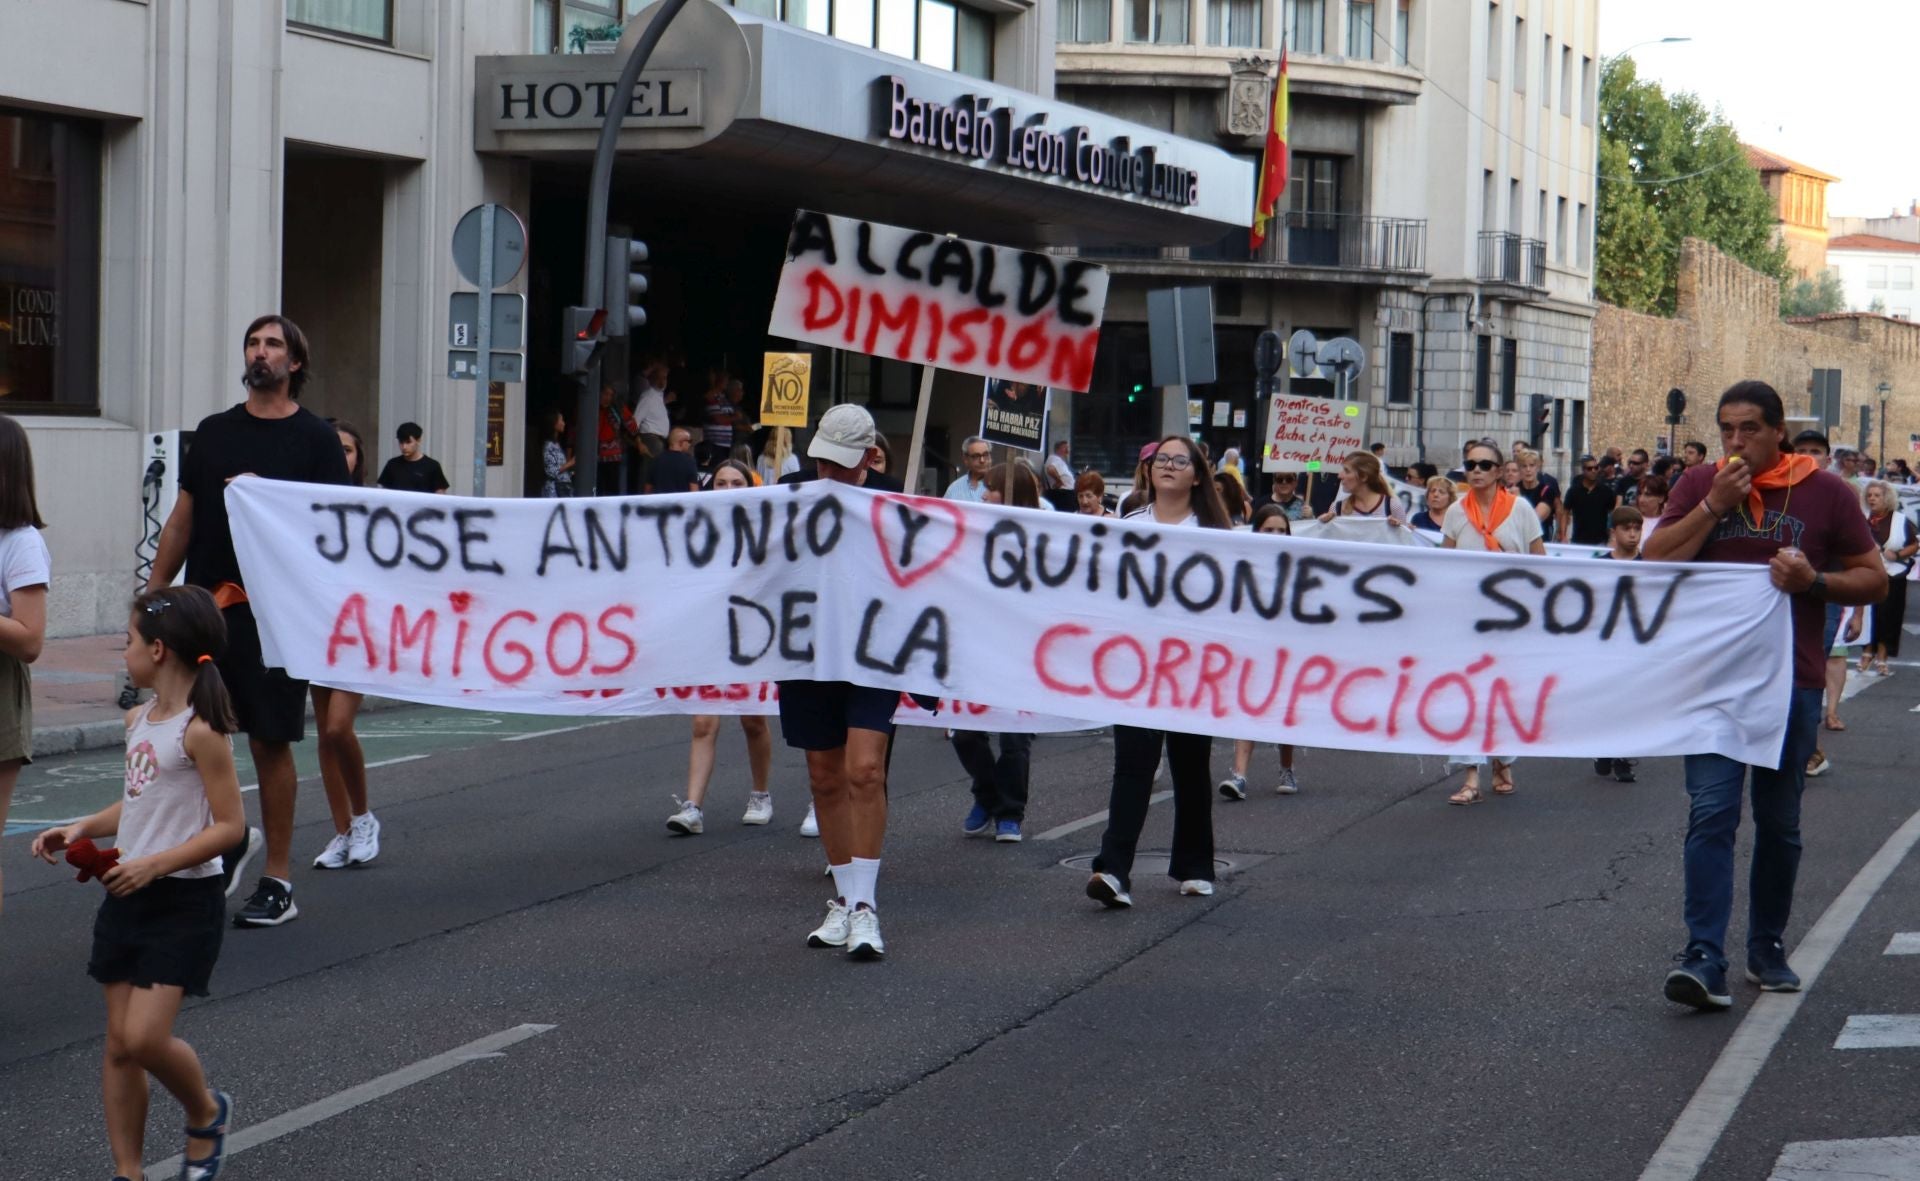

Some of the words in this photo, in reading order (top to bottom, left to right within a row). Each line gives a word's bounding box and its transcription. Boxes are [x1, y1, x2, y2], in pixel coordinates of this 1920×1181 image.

[501, 81, 689, 119] HOTEL
[888, 75, 995, 160] Barceló
[1006, 107, 1067, 176] León
[1075, 125, 1144, 194] Conde
[1150, 146, 1199, 206] Luna
[788, 212, 1105, 327] ALCALDE
[18, 288, 61, 315] CONDE
[18, 316, 61, 346] LUNA
[802, 267, 1099, 392] DIMISIÓN
[765, 376, 799, 404] NO
[986, 421, 1000, 430] PARA
[1000, 424, 1011, 433] LOS
[987, 408, 998, 421] NO
[1024, 416, 1040, 430] PAZ
[311, 502, 504, 576] JOSE
[896, 503, 930, 568] Y
[1474, 566, 1696, 644] SON
[728, 590, 818, 666] DE
[855, 598, 951, 682] LA
